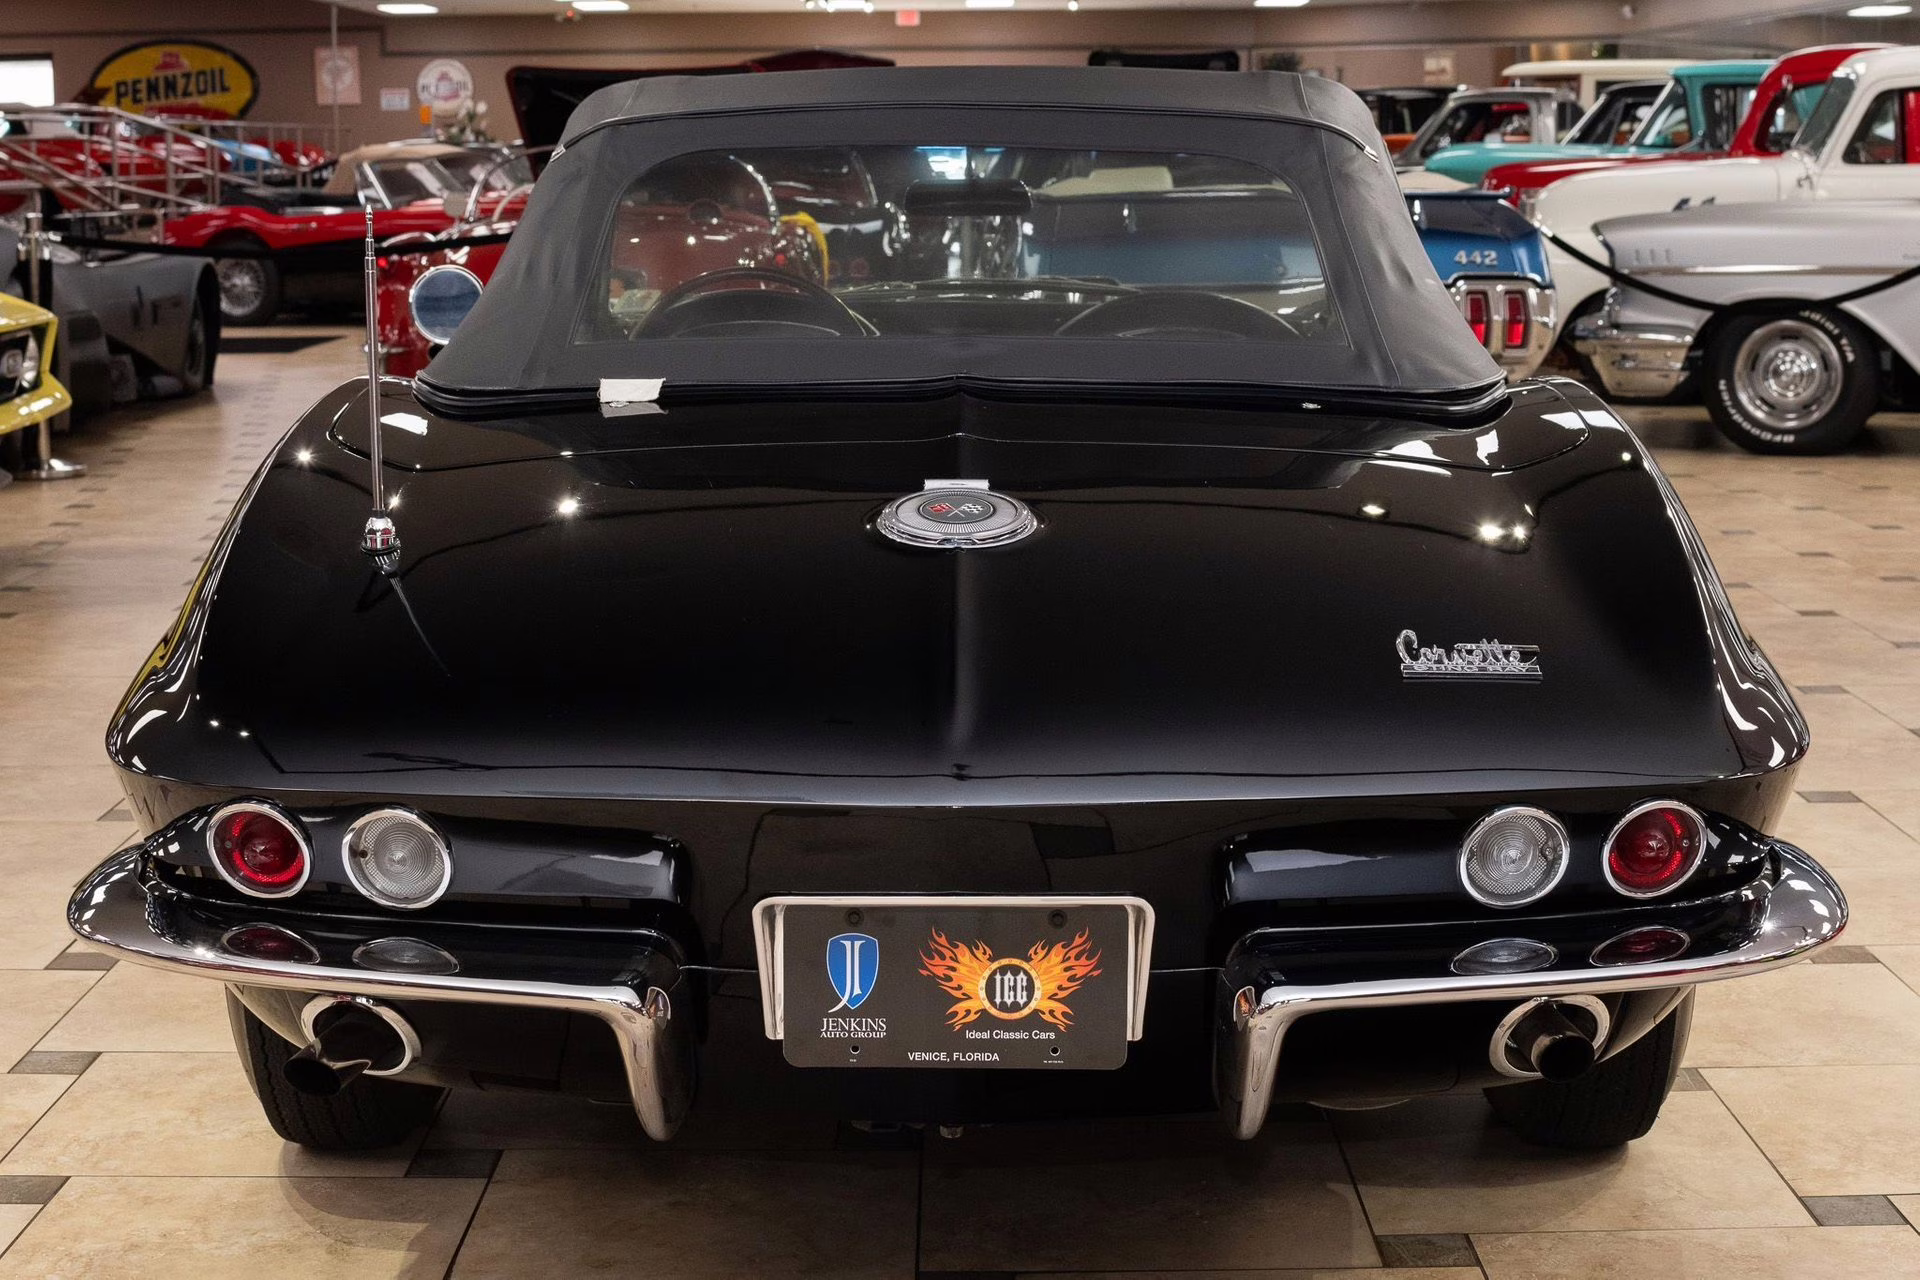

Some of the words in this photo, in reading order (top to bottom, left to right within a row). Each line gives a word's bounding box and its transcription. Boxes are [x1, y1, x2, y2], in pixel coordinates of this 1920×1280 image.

[115, 68, 231, 106] PENNZOIL
[1454, 250, 1498, 265] 442
[1396, 629, 1540, 665] Corvette
[820, 1018, 887, 1032] JENKINS
[965, 1030, 990, 1039] Ideal
[992, 1030, 1029, 1040] Classic
[1031, 1030, 1056, 1040] Cars
[908, 1052, 950, 1062] VENICE,
[953, 1053, 1000, 1062] FLORIDA
